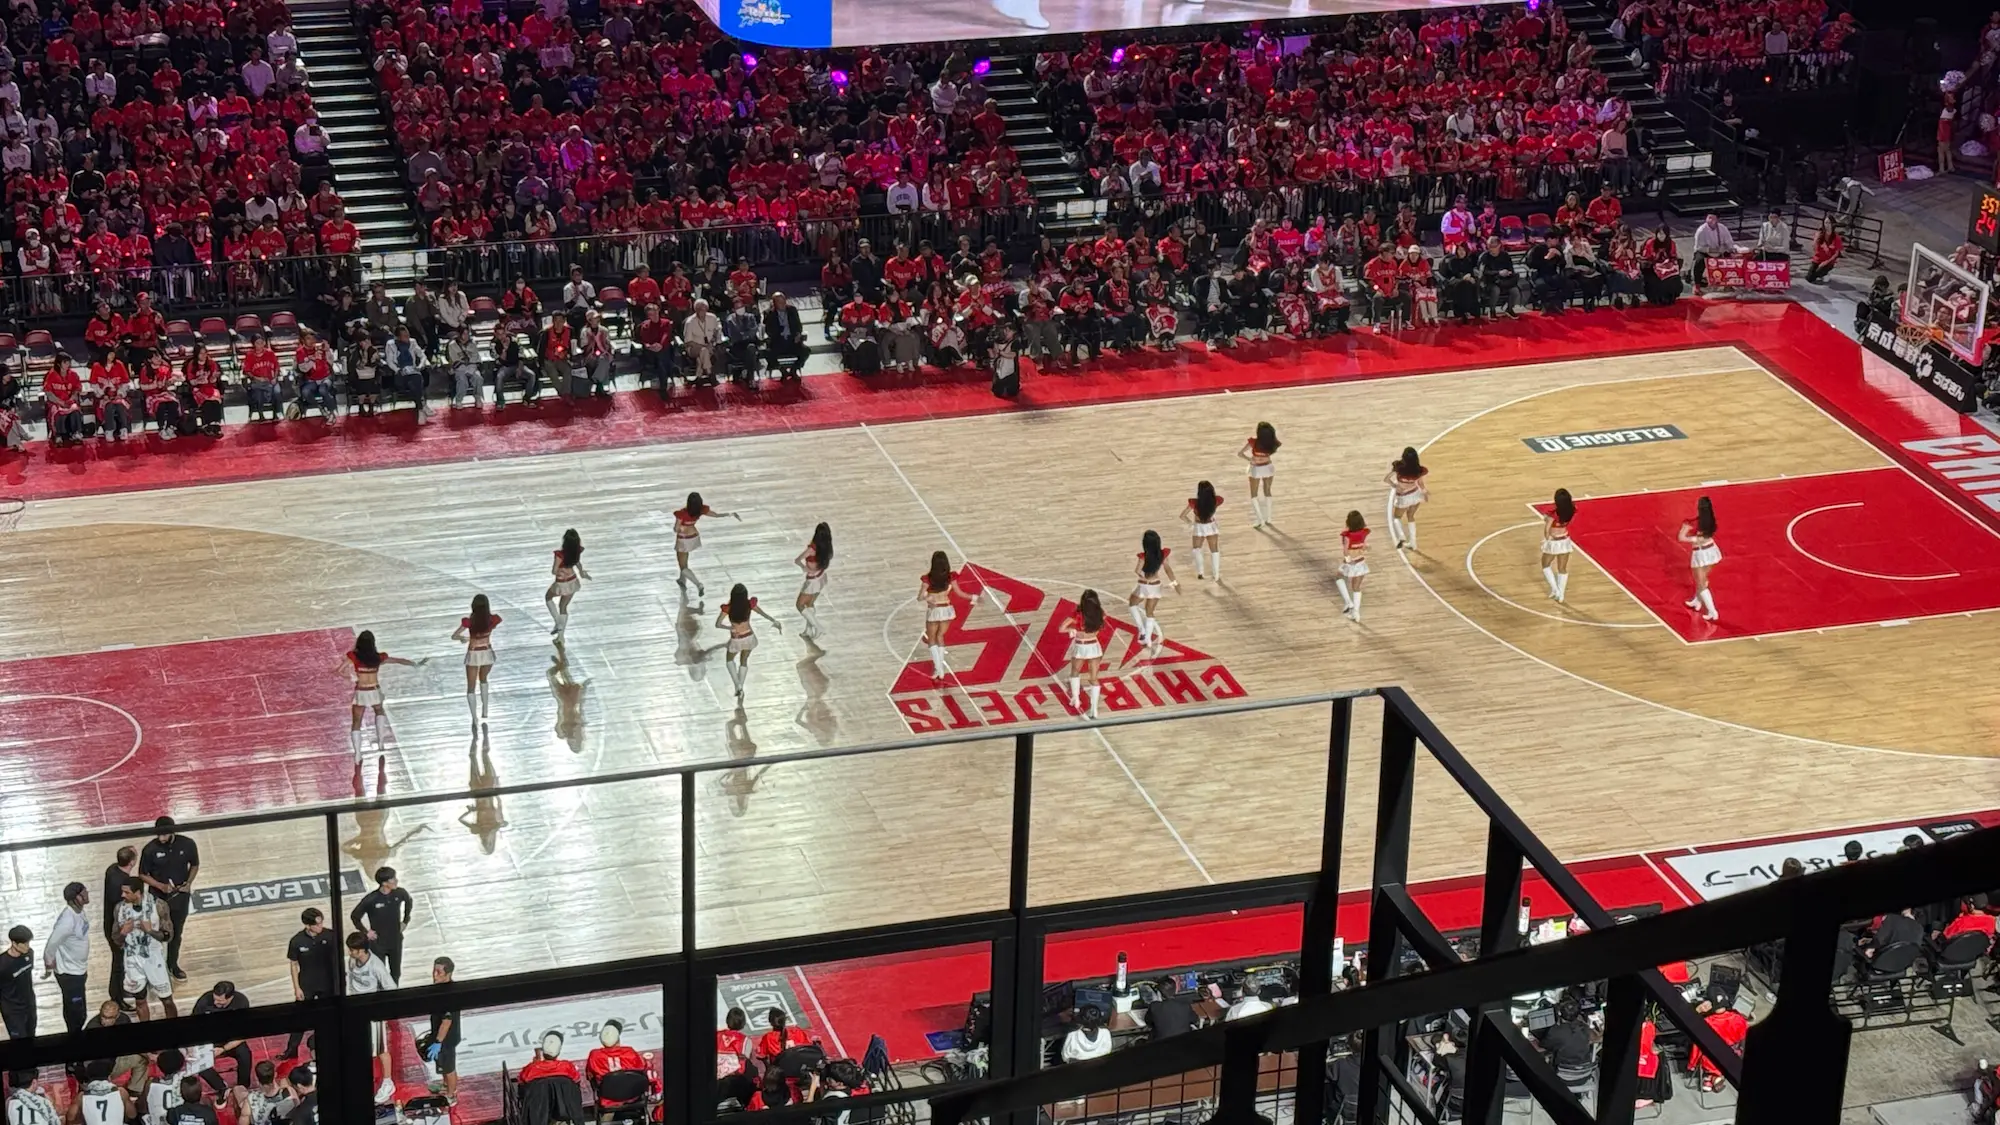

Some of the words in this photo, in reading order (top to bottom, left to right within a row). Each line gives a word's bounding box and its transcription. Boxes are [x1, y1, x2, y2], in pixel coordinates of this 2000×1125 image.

[1975, 211, 1996, 237] 24
[1757, 262, 1786, 271] コジマ
[1932, 372, 1965, 401] ちばぎん
[1567, 427, 1673, 447] B.LEAGUE
[16, 1105, 38, 1125] 11
[96, 1100, 108, 1122] 7
